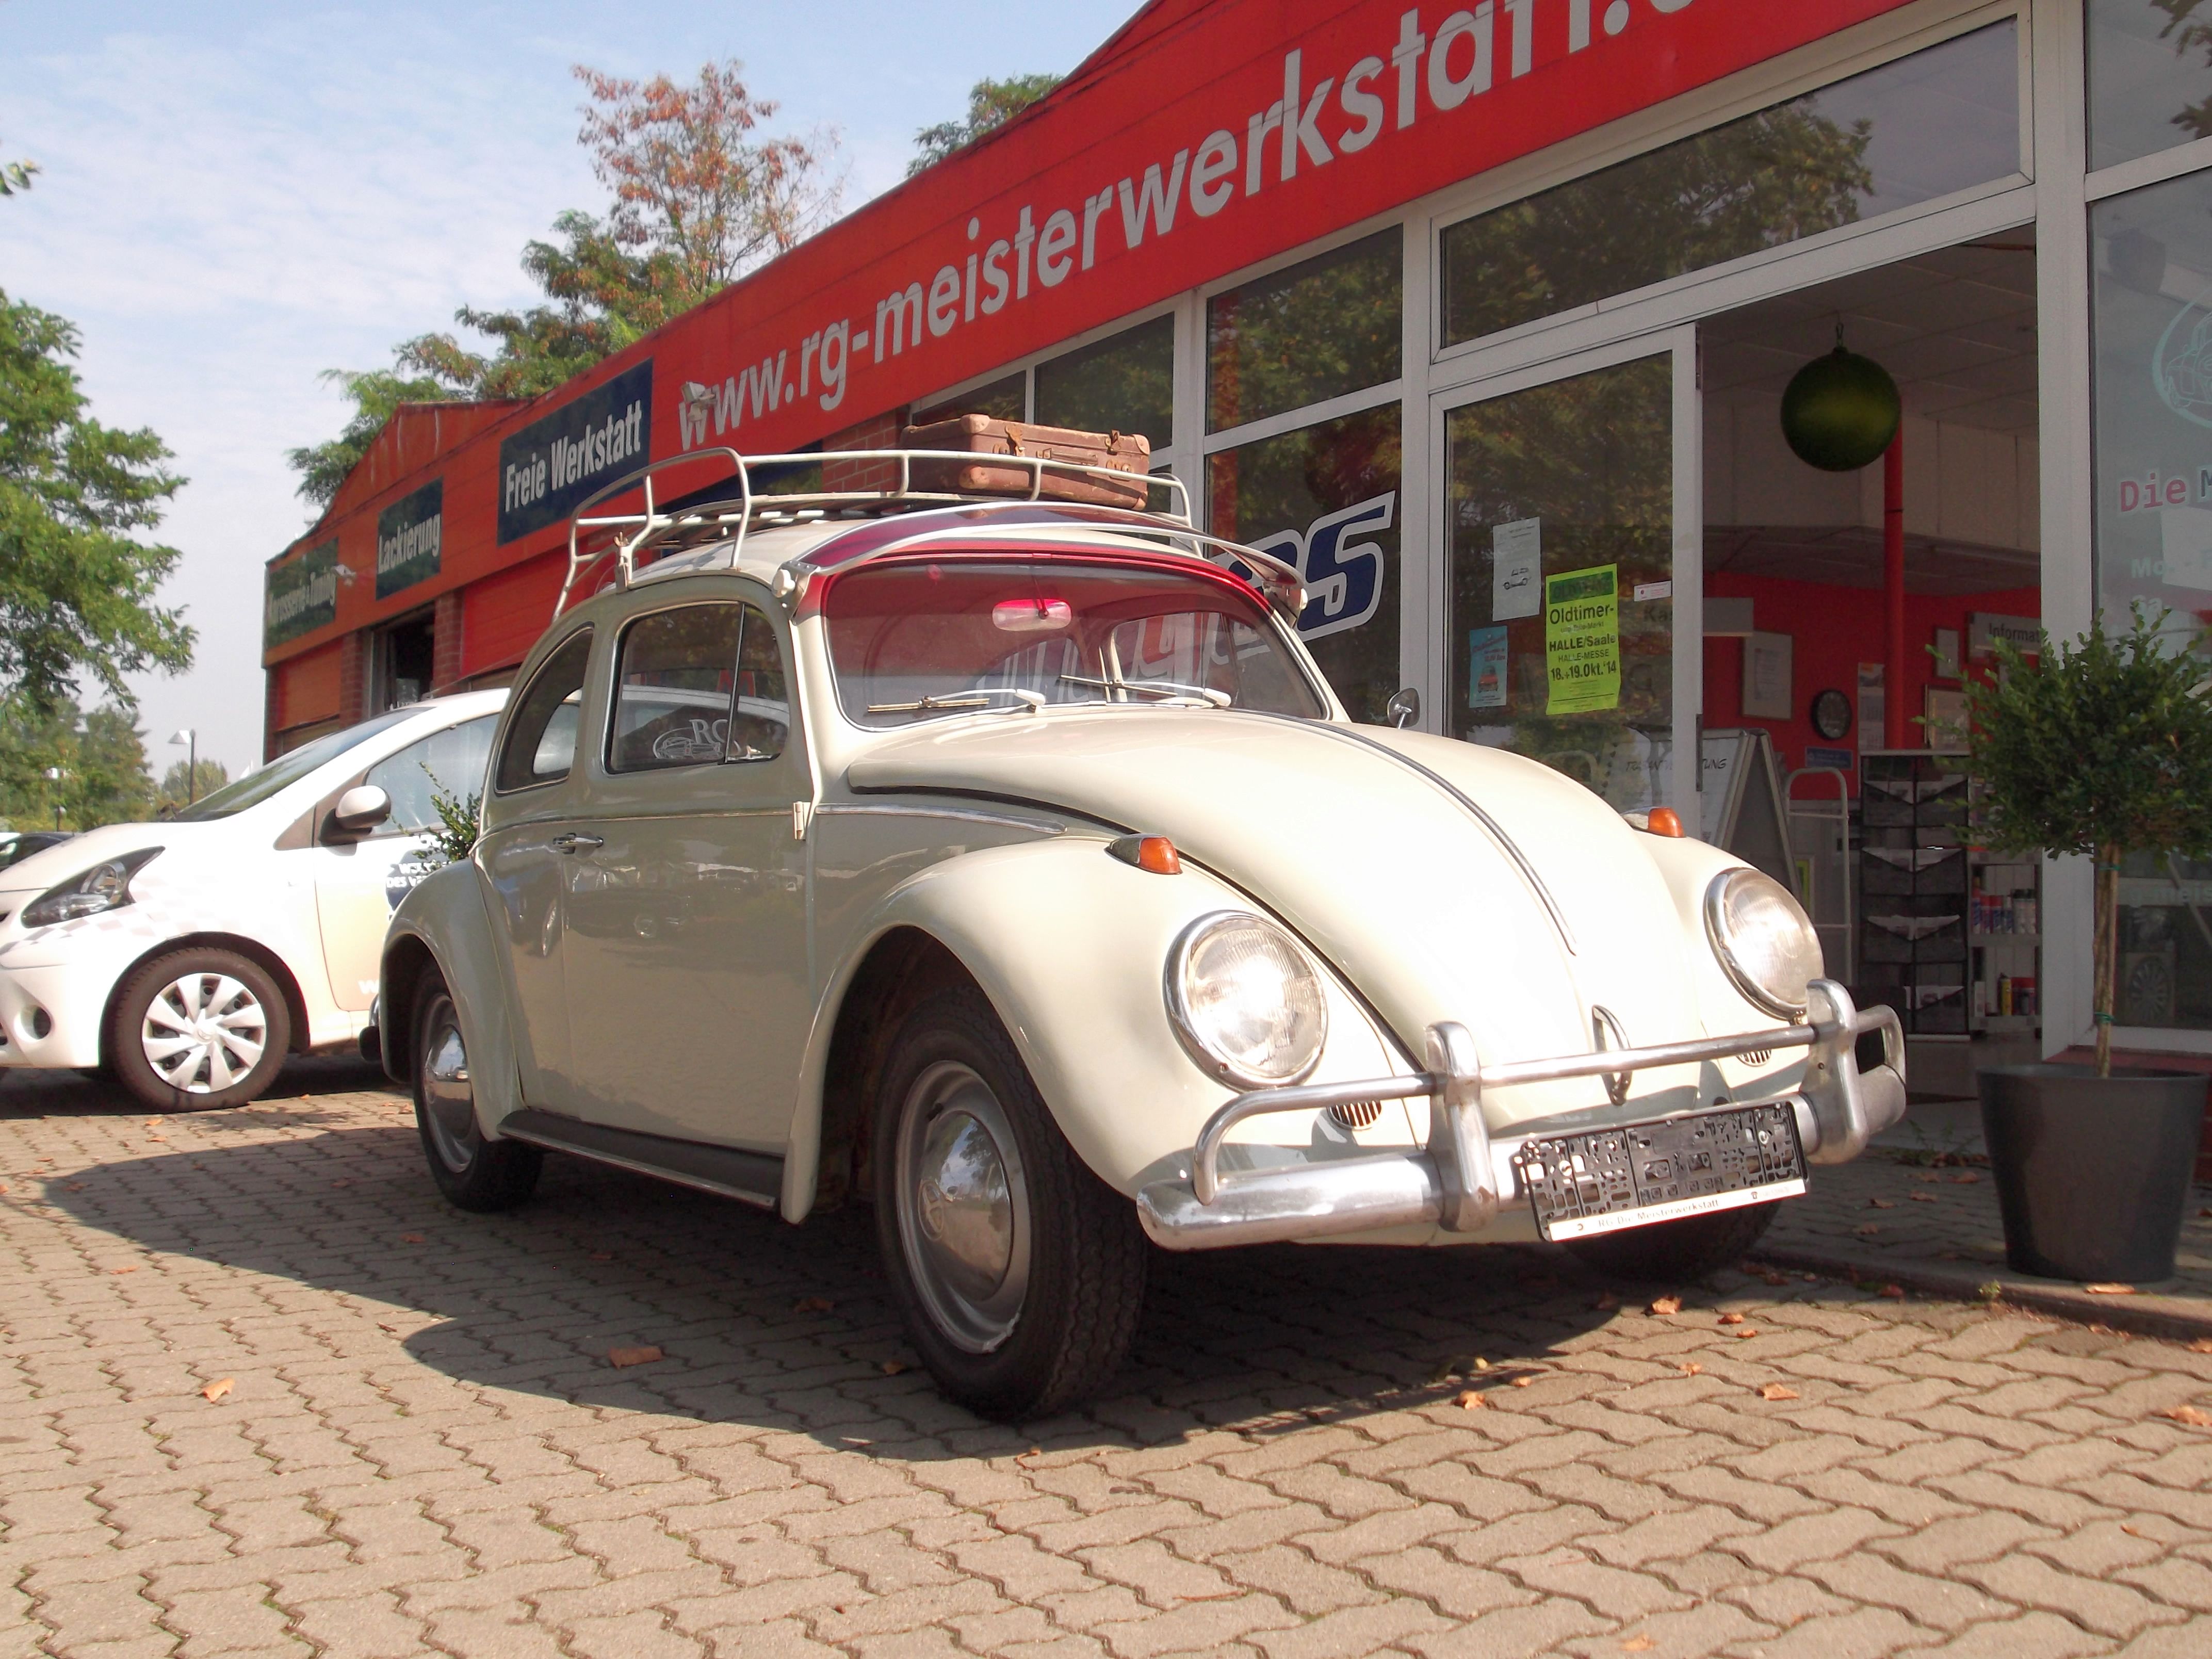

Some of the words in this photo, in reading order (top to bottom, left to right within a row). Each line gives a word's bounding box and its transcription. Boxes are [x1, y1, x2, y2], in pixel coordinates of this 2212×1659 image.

[506, 452, 546, 512] Freie
[551, 399, 642, 491] Werkstatt
[2120, 472, 2187, 512] Die
[378, 513, 441, 575] Lackierung
[1550, 605, 1614, 625] Oldtimer-
[1549, 633, 1616, 652] HALLE/Saale
[1558, 648, 1609, 663] HALLE-MESSE
[386, 876, 407, 888] DES
[1637, 1199, 1719, 1221] Meisterwerkstatt
